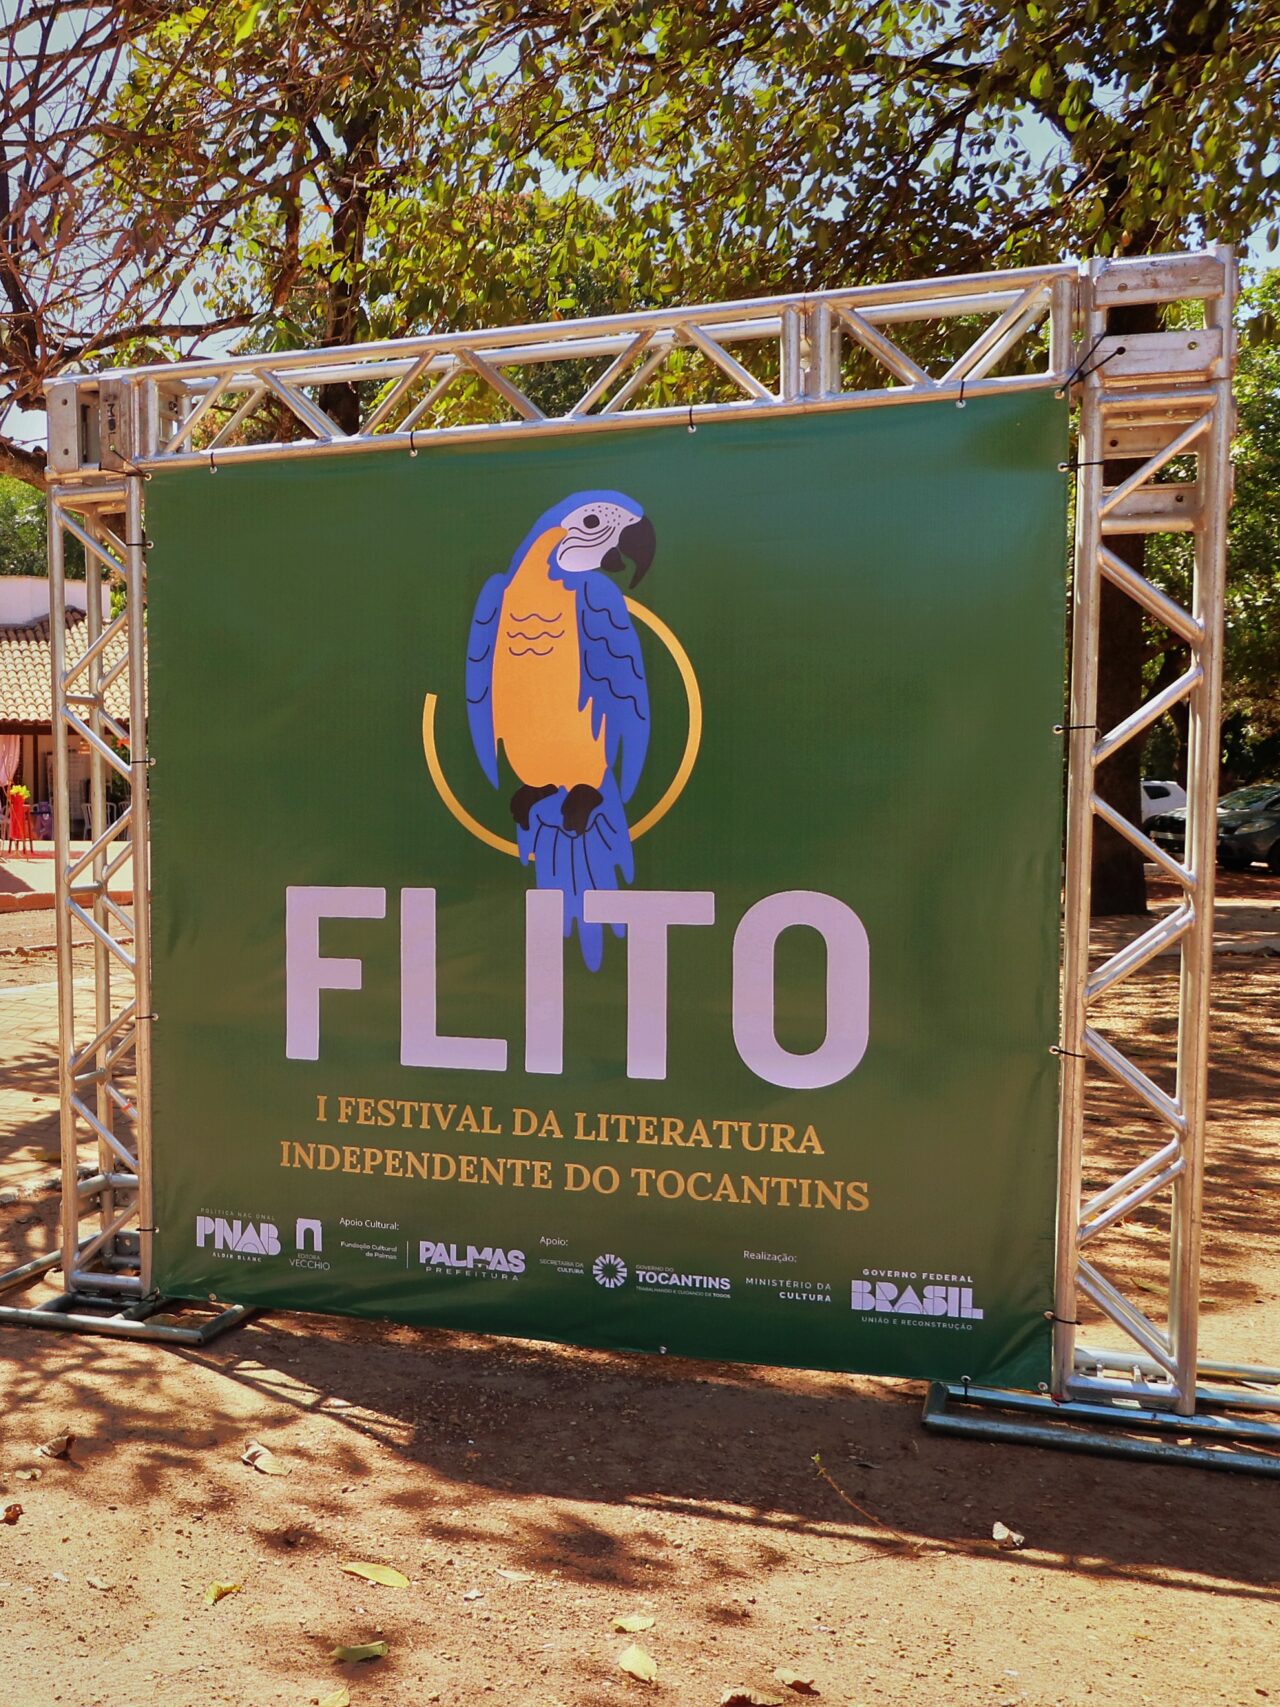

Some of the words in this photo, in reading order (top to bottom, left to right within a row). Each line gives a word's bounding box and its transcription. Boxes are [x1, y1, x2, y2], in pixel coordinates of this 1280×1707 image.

[285, 886, 870, 1090] FLITO
[316, 1095, 327, 1121] I
[337, 1096, 502, 1135] FESTIVAL
[512, 1108, 564, 1139] DA
[574, 1112, 825, 1155] LITERATURA
[280, 1141, 553, 1190] INDEPENDENTE
[564, 1163, 620, 1194] DO
[630, 1167, 871, 1212] TOCANTINS
[339, 1217, 363, 1227] Apoio
[364, 1219, 400, 1231] Cultural:
[196, 1215, 281, 1256] PNAB
[539, 1236, 568, 1247] Apoio:
[420, 1241, 526, 1273] PALMAS
[743, 1250, 797, 1263] Realização:
[289, 1258, 331, 1271] VECCHIO
[556, 1266, 584, 1275] CULTURA
[425, 1266, 520, 1281] PREFEITURA
[635, 1270, 731, 1290] TOCANTINS
[862, 1268, 918, 1279] GOVERNO
[922, 1271, 974, 1283] FEDERAL
[745, 1277, 812, 1290] MINISTÉRIO
[816, 1282, 832, 1291] DA
[778, 1291, 832, 1303] CULTURA
[851, 1279, 984, 1320] BRASIL
[861, 1315, 890, 1325] UNIÃO
[900, 1318, 973, 1331] RECONSTRUÇÃO
